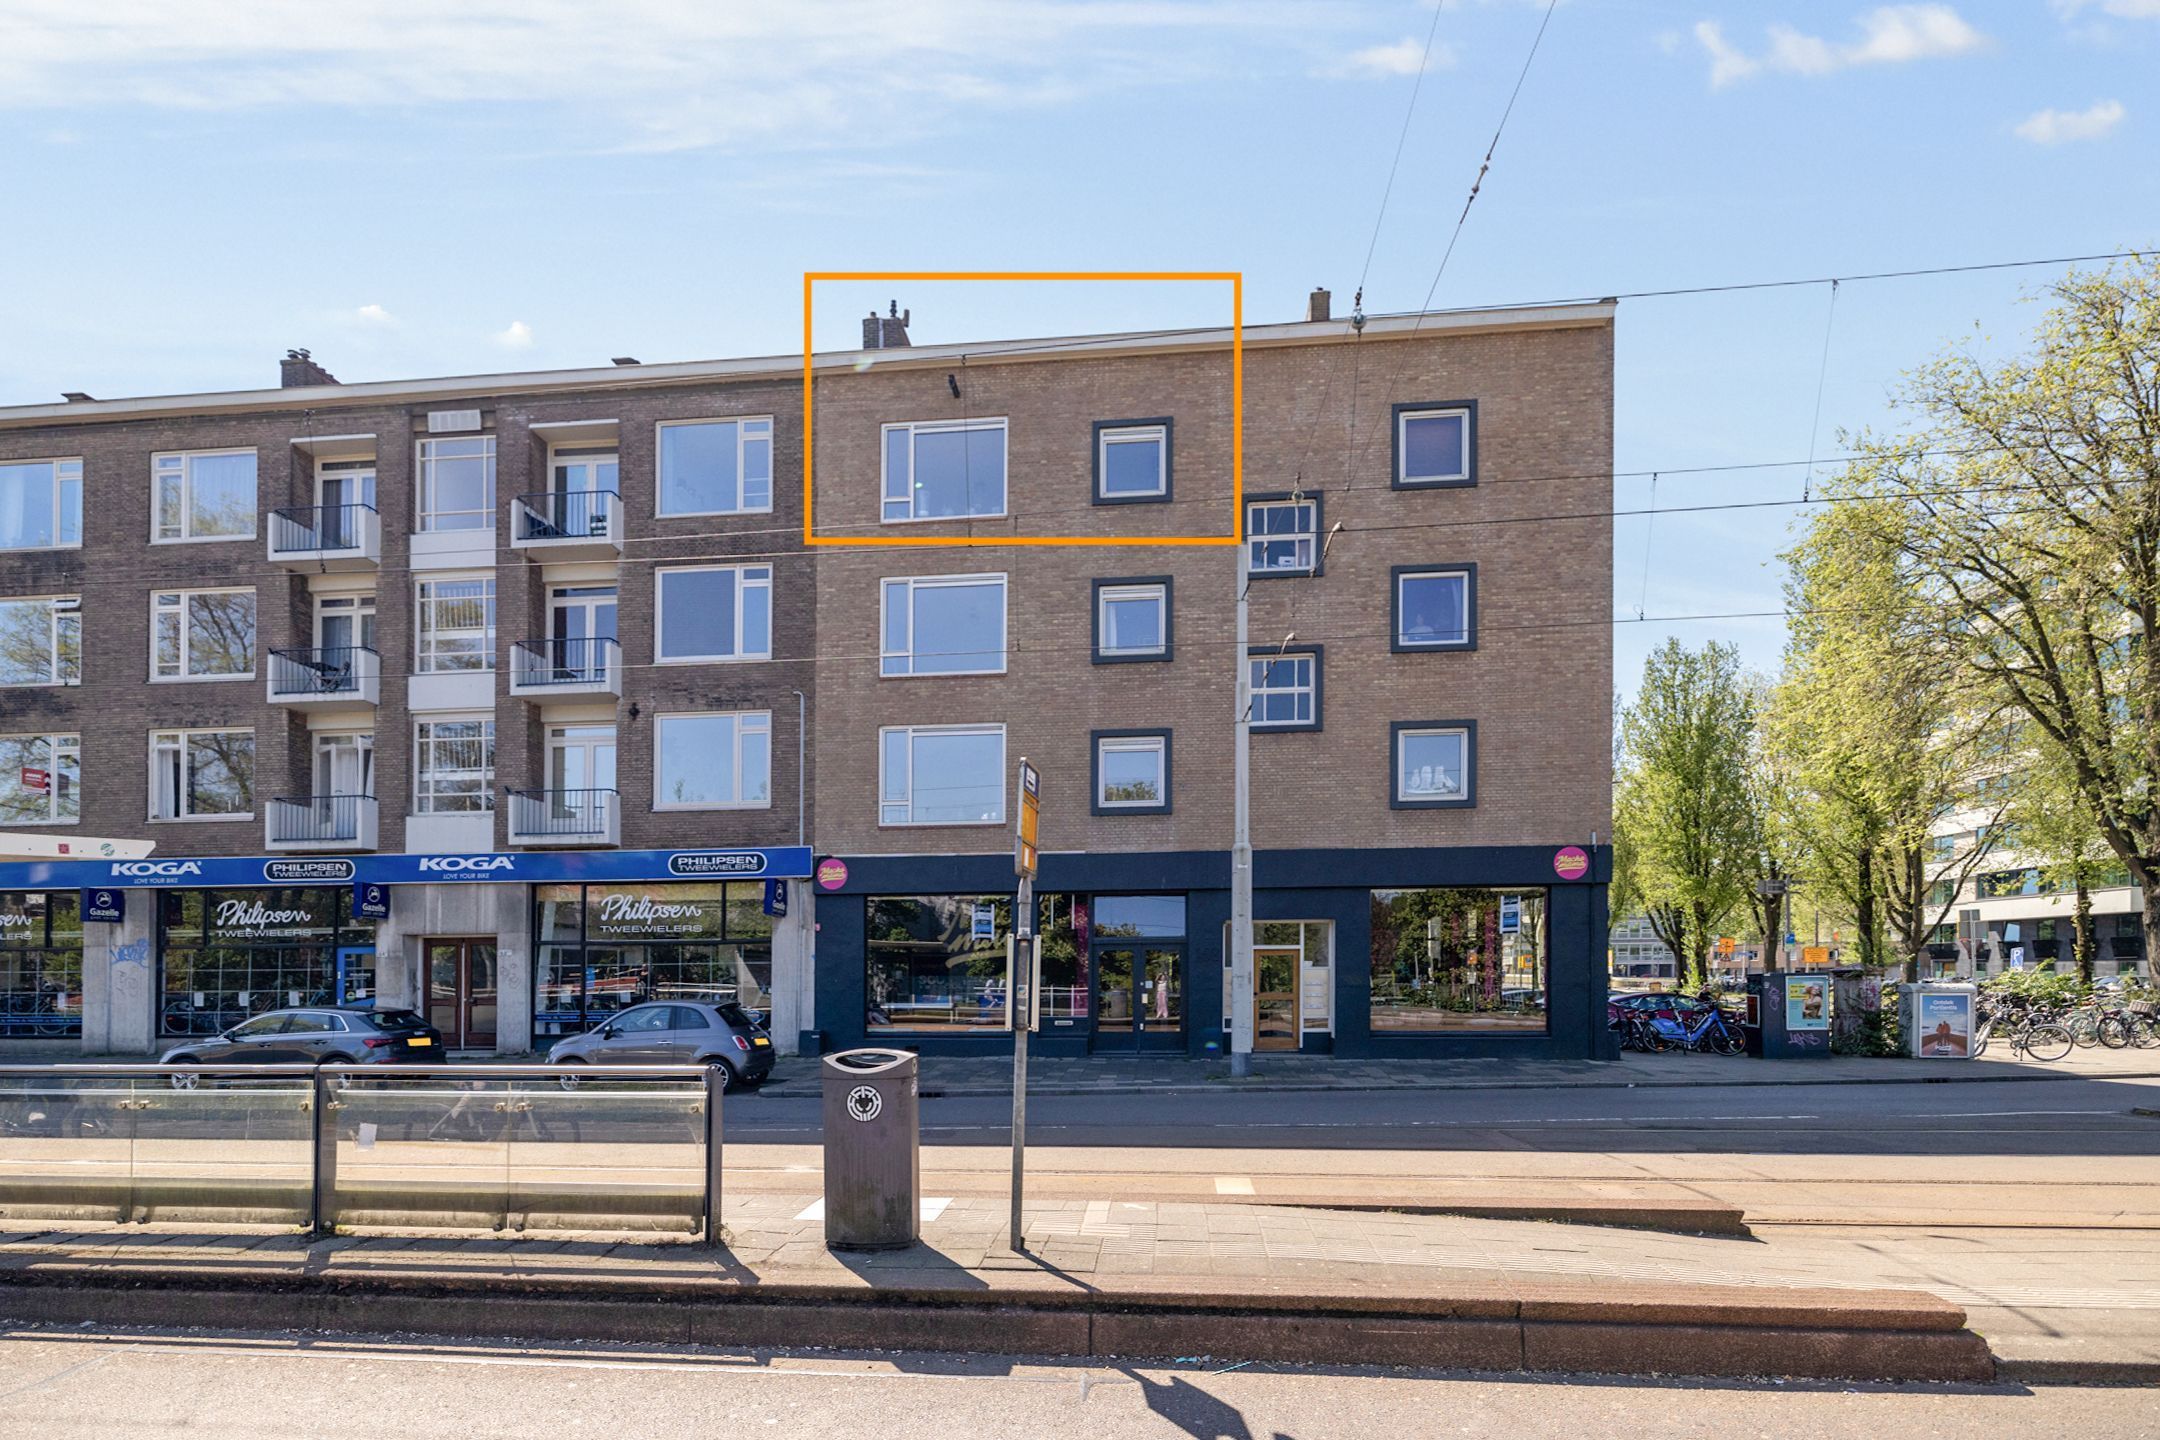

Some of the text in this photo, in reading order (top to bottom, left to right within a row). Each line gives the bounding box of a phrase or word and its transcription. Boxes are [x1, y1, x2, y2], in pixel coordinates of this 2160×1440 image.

[419, 856, 515, 871] KOGA
[677, 856, 758, 866] PHILIPSEN
[111, 862, 202, 876] KOGA
[272, 863, 347, 872] PHILIPSEN
[677, 864, 758, 872] TWEEWIELERS
[89, 907, 120, 917] Gazelle
[362, 902, 386, 913] Gazelle
[601, 894, 702, 925] Philipsen
[216, 900, 312, 929] Philipsen
[216, 929, 312, 938] TWEEWIELERS
[600, 925, 702, 933] TWEEWIELERS
